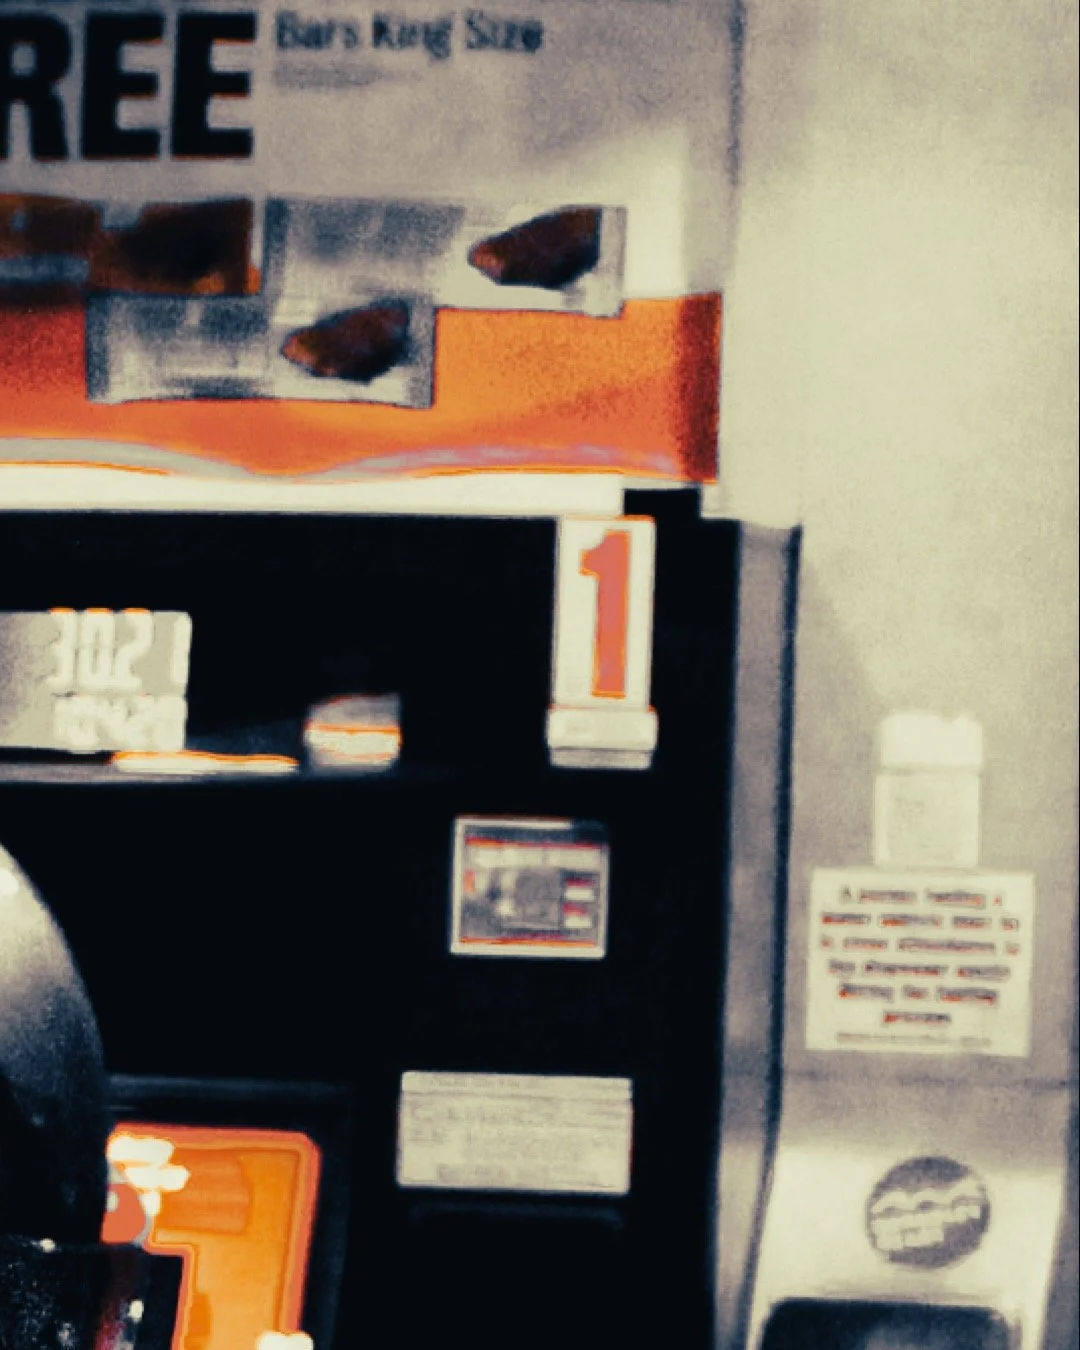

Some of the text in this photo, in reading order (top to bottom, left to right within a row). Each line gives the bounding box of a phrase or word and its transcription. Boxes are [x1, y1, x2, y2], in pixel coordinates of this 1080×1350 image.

[275, 9, 544, 61] Bars King Size
[579, 529, 631, 699] 1
